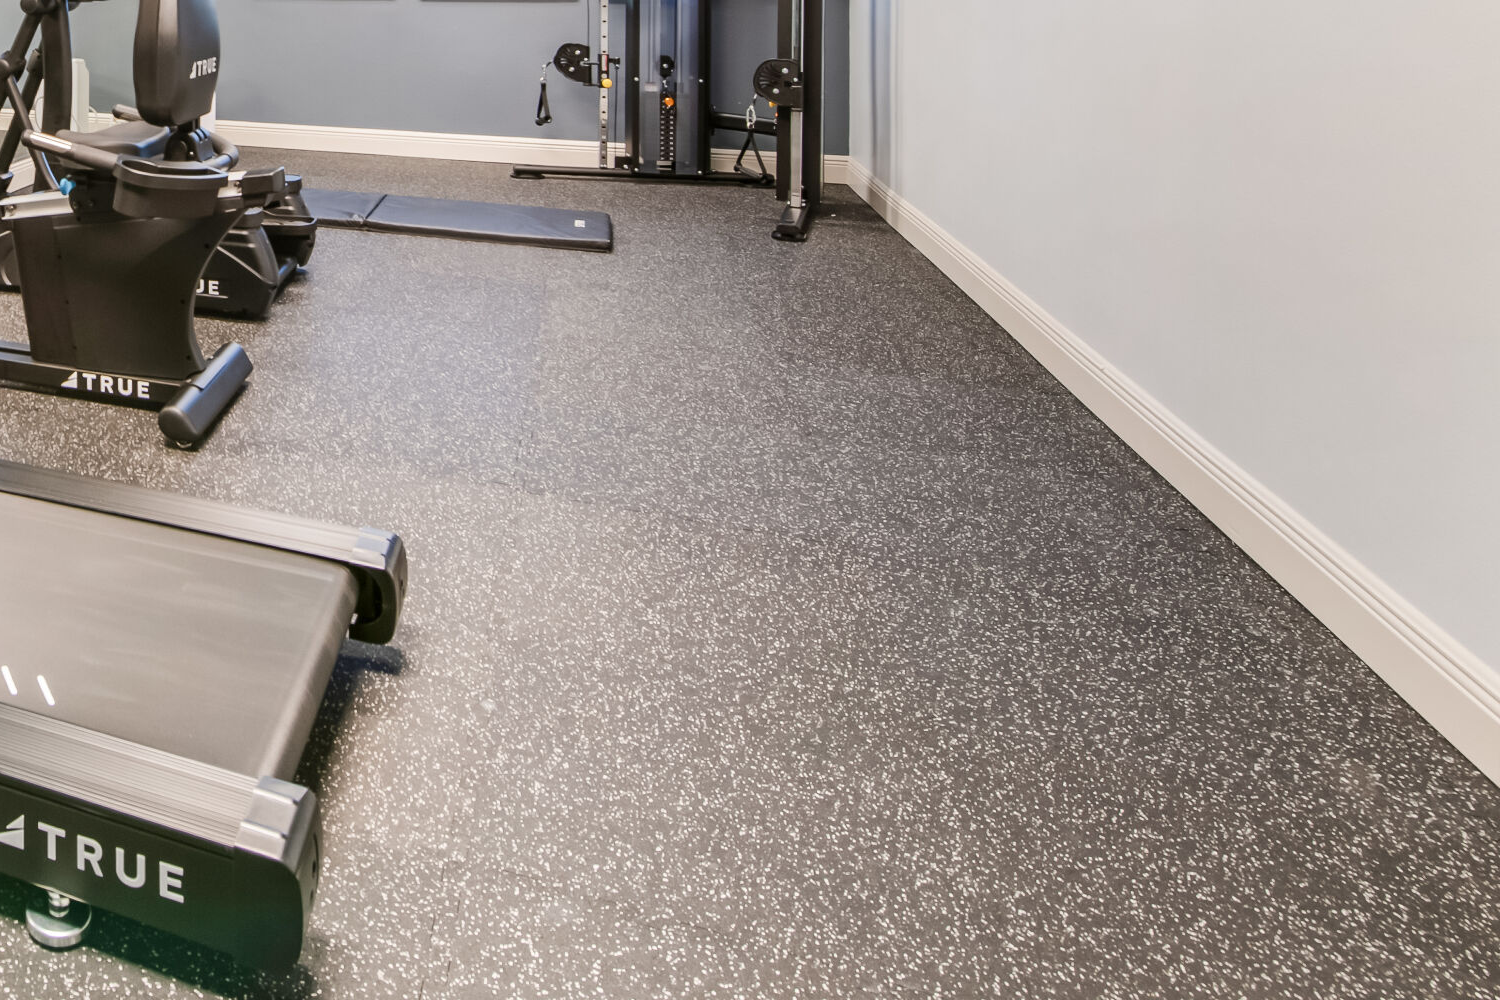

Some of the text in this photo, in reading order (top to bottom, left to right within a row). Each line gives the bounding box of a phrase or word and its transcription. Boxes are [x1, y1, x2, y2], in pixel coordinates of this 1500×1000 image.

[196, 56, 217, 77] TRUE
[81, 372, 151, 400] TRUE
[38, 821, 185, 904] TRUE
